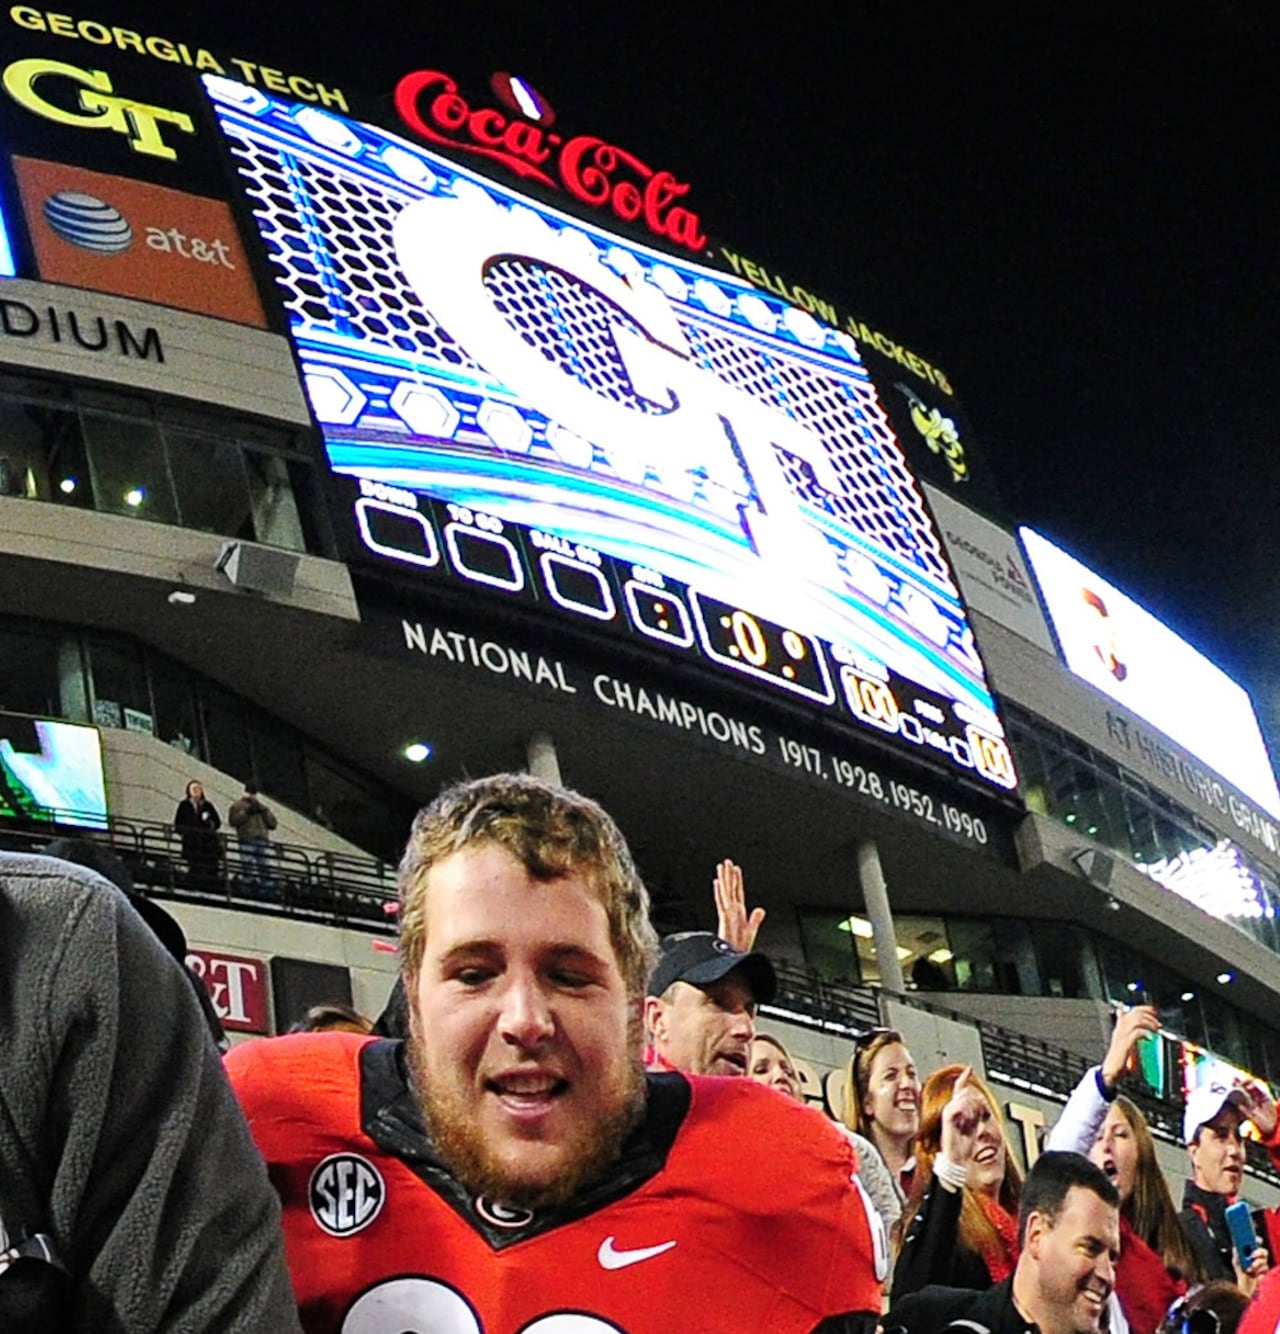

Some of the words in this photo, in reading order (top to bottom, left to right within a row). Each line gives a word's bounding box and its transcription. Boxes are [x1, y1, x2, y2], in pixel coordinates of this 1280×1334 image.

[2, 57, 196, 160] GT
[11, 5, 227, 75] GEORGIA
[231, 58, 350, 112] TECH
[394, 69, 708, 250] Coca-Cola
[145, 223, 236, 271] at&t
[721, 246, 839, 326] YELLOW
[845, 316, 954, 396] JACKETS
[401, 619, 577, 694] NATIONAL
[593, 674, 766, 754] CHAMPIONS
[942, 803, 988, 845] 1990
[312, 1156, 382, 1233] SEC
